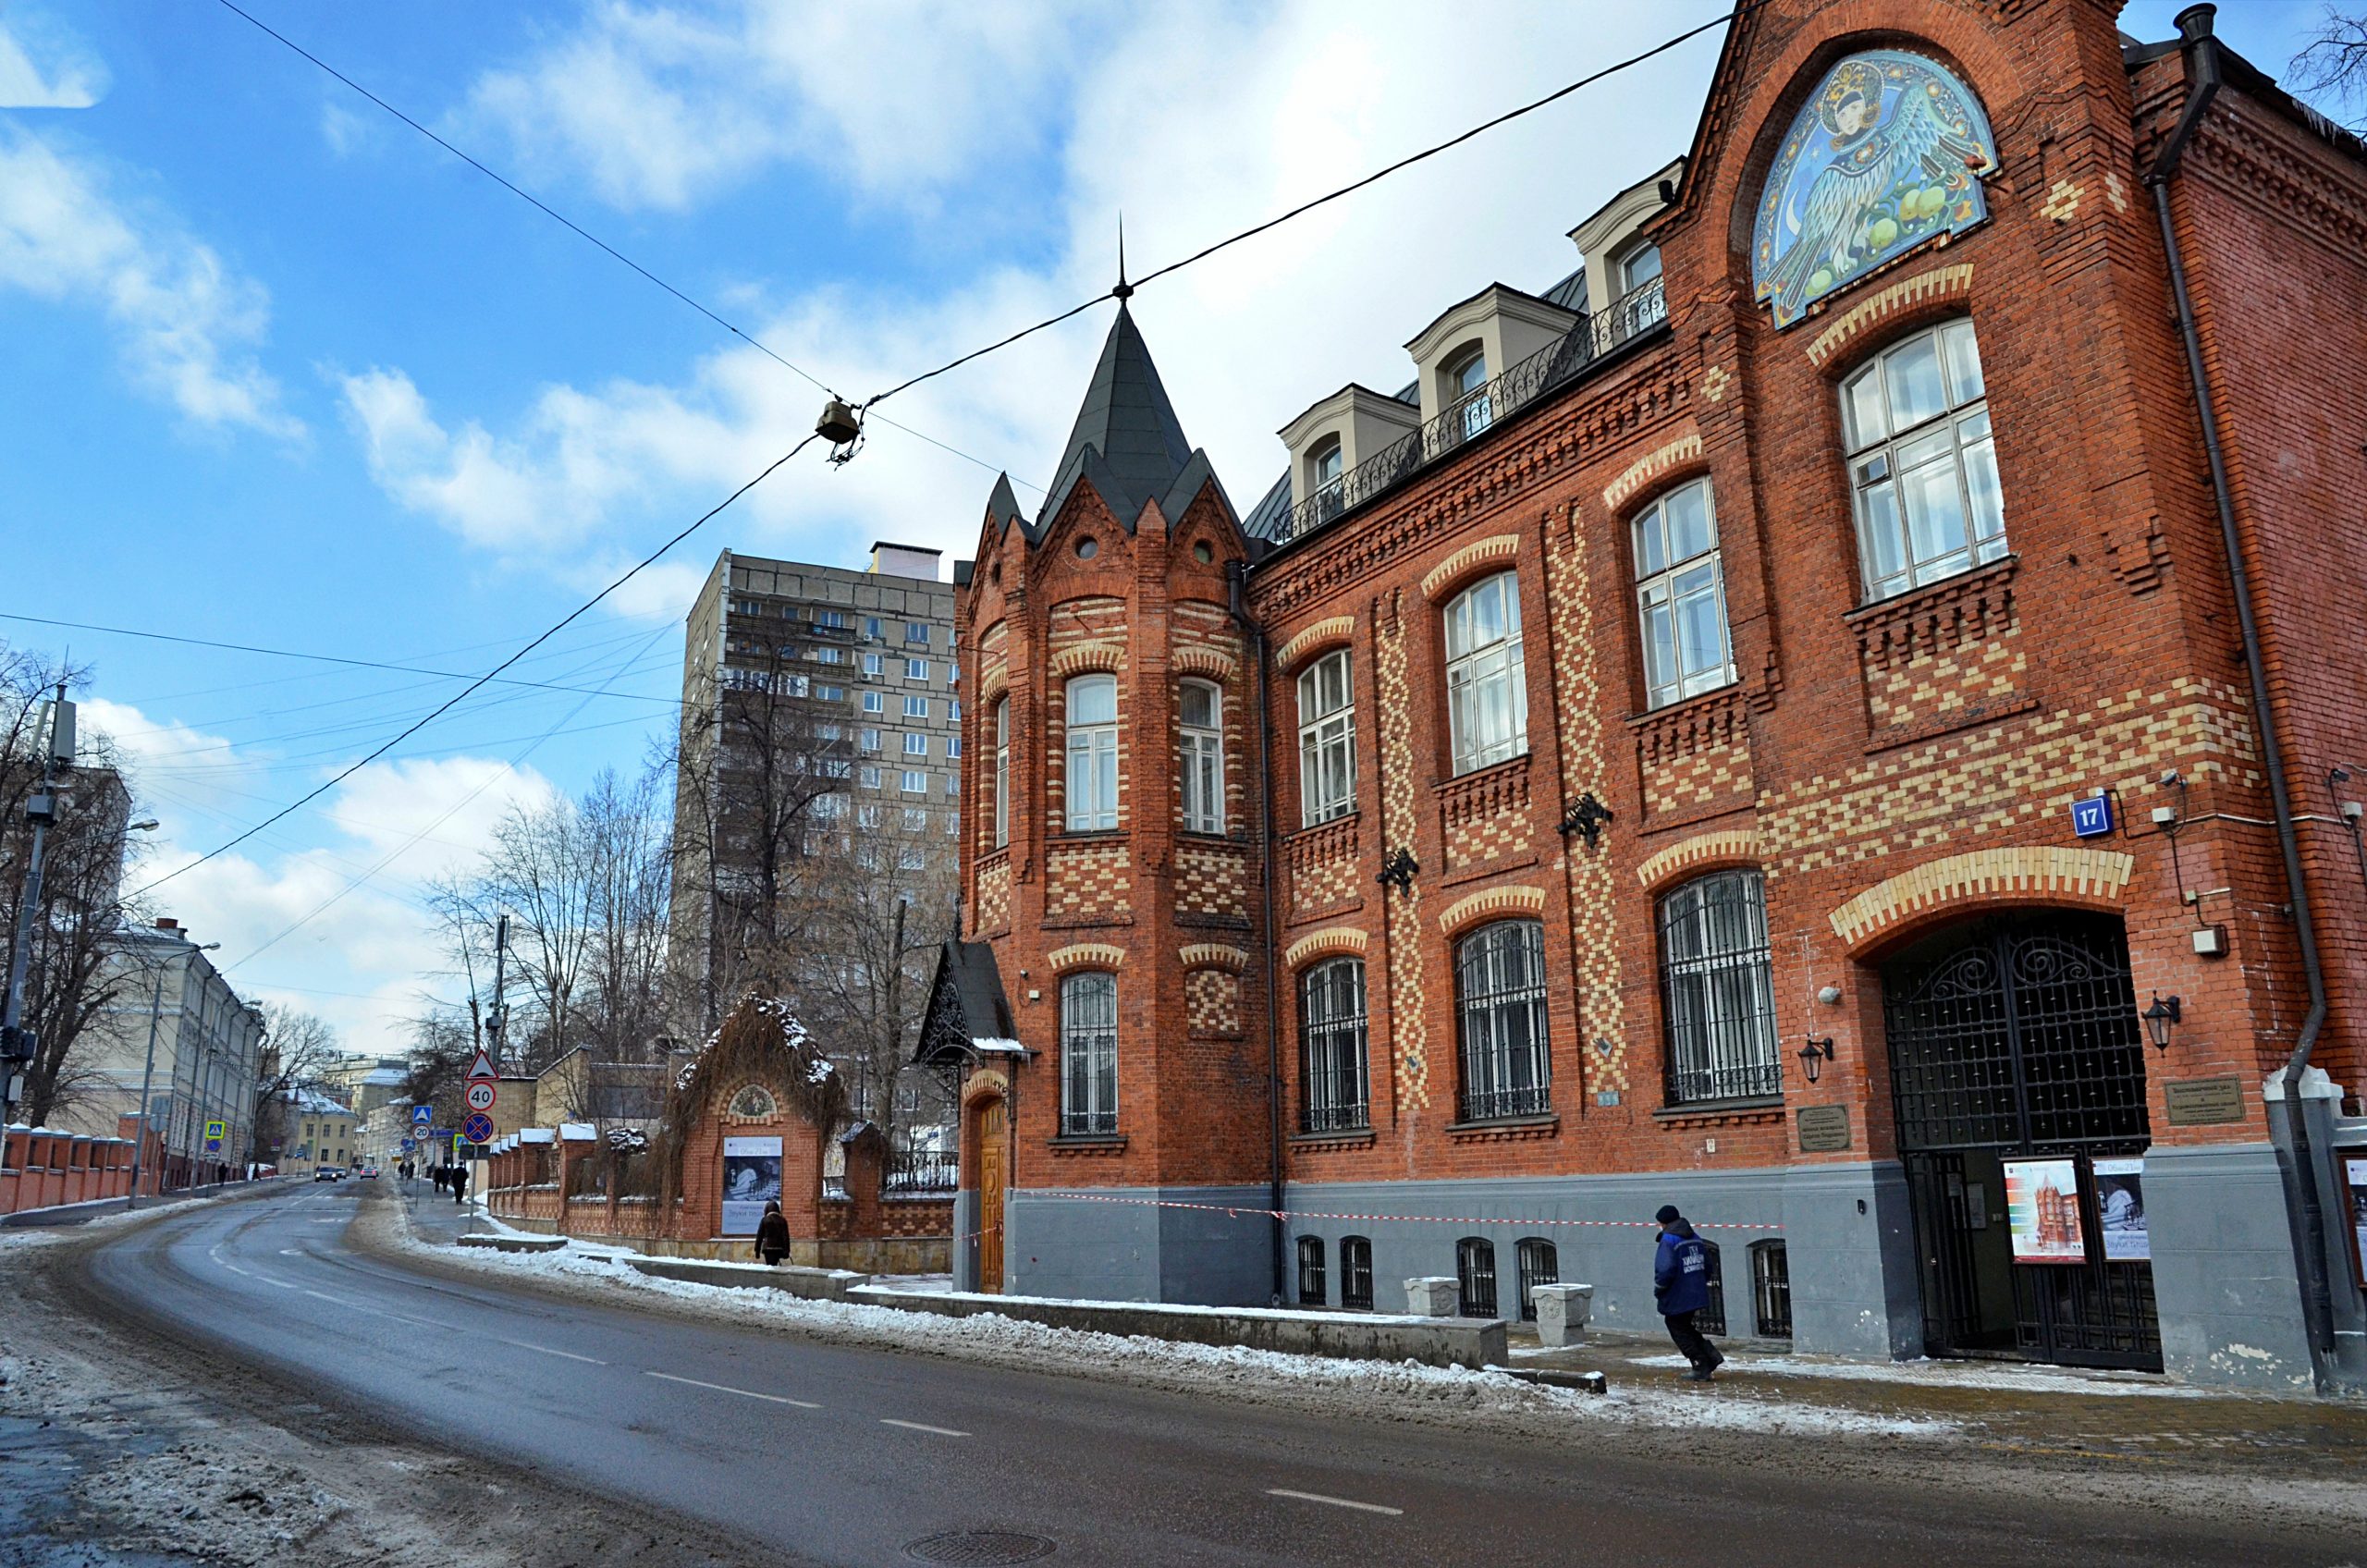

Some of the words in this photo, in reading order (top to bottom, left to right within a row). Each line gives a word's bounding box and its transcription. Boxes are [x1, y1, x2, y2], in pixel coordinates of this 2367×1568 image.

[2079, 808, 2098, 827] 17
[472, 1091, 490, 1102] 40
[416, 1128, 427, 1136] 20
